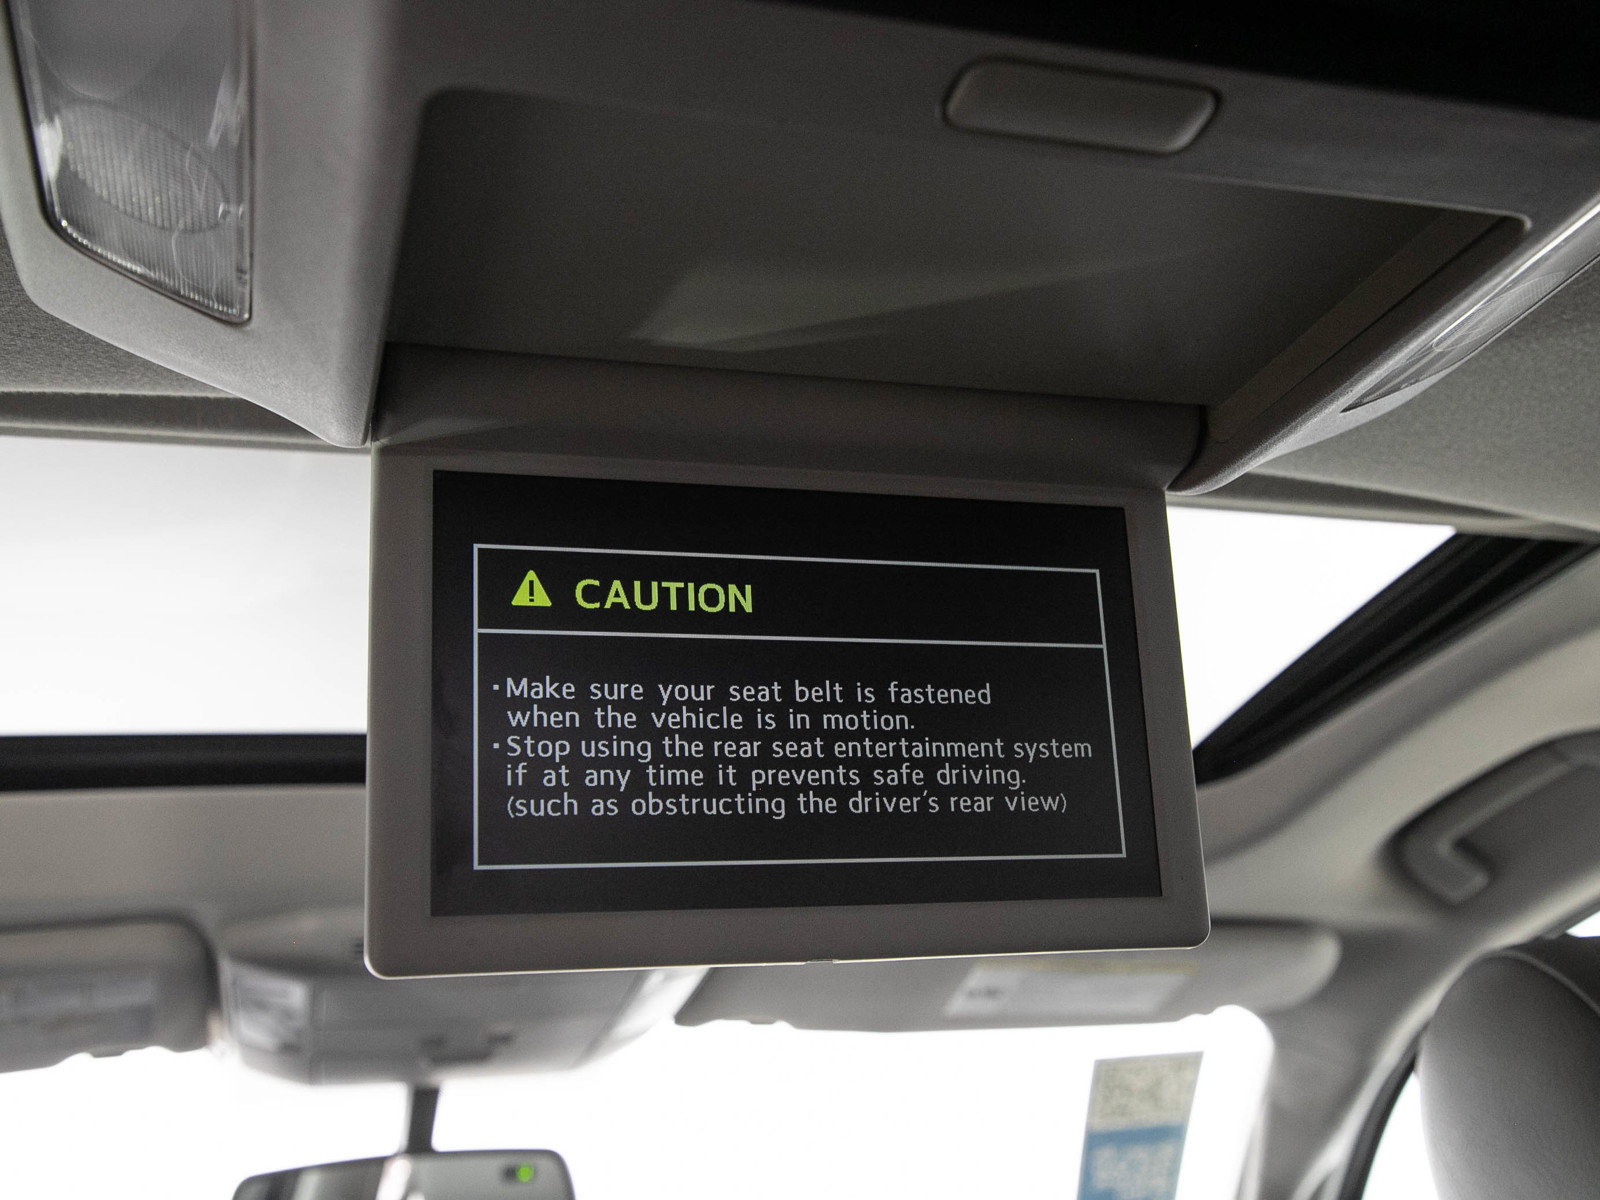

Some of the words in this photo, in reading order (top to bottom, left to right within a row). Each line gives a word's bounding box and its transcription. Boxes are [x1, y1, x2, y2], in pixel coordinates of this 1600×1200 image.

[575, 579, 752, 612] CAUTION
[507, 676, 575, 699] Make
[590, 683, 643, 700] sure
[658, 684, 715, 705] your
[729, 682, 782, 702] seat
[795, 680, 843, 702] belt
[857, 683, 875, 703] is
[888, 681, 990, 704] fastened
[507, 704, 579, 728] when
[594, 705, 636, 728] the
[651, 706, 742, 729] vehicle
[757, 708, 776, 729] is
[790, 709, 809, 729] in
[823, 710, 914, 730] motion.
[507, 736, 570, 762] Stop
[581, 735, 651, 762] using
[662, 734, 703, 757] the
[714, 741, 761, 757] rear
[772, 738, 824, 757] seat
[835, 737, 1004, 758] entertainment
[1014, 739, 1091, 763] system
[507, 762, 527, 786] if
[543, 765, 569, 787] at
[585, 770, 631, 792] any
[646, 764, 703, 786] time
[719, 764, 736, 786] it
[752, 765, 860, 791] prevents
[874, 763, 924, 785] safe
[937, 763, 1025, 790] driving.
[507, 792, 578, 818] (such
[591, 799, 618, 816] as
[632, 792, 785, 819] obstructing
[797, 791, 837, 813] the
[849, 790, 939, 813] driver's
[951, 797, 994, 812] rear
[1005, 792, 1066, 813] view)
